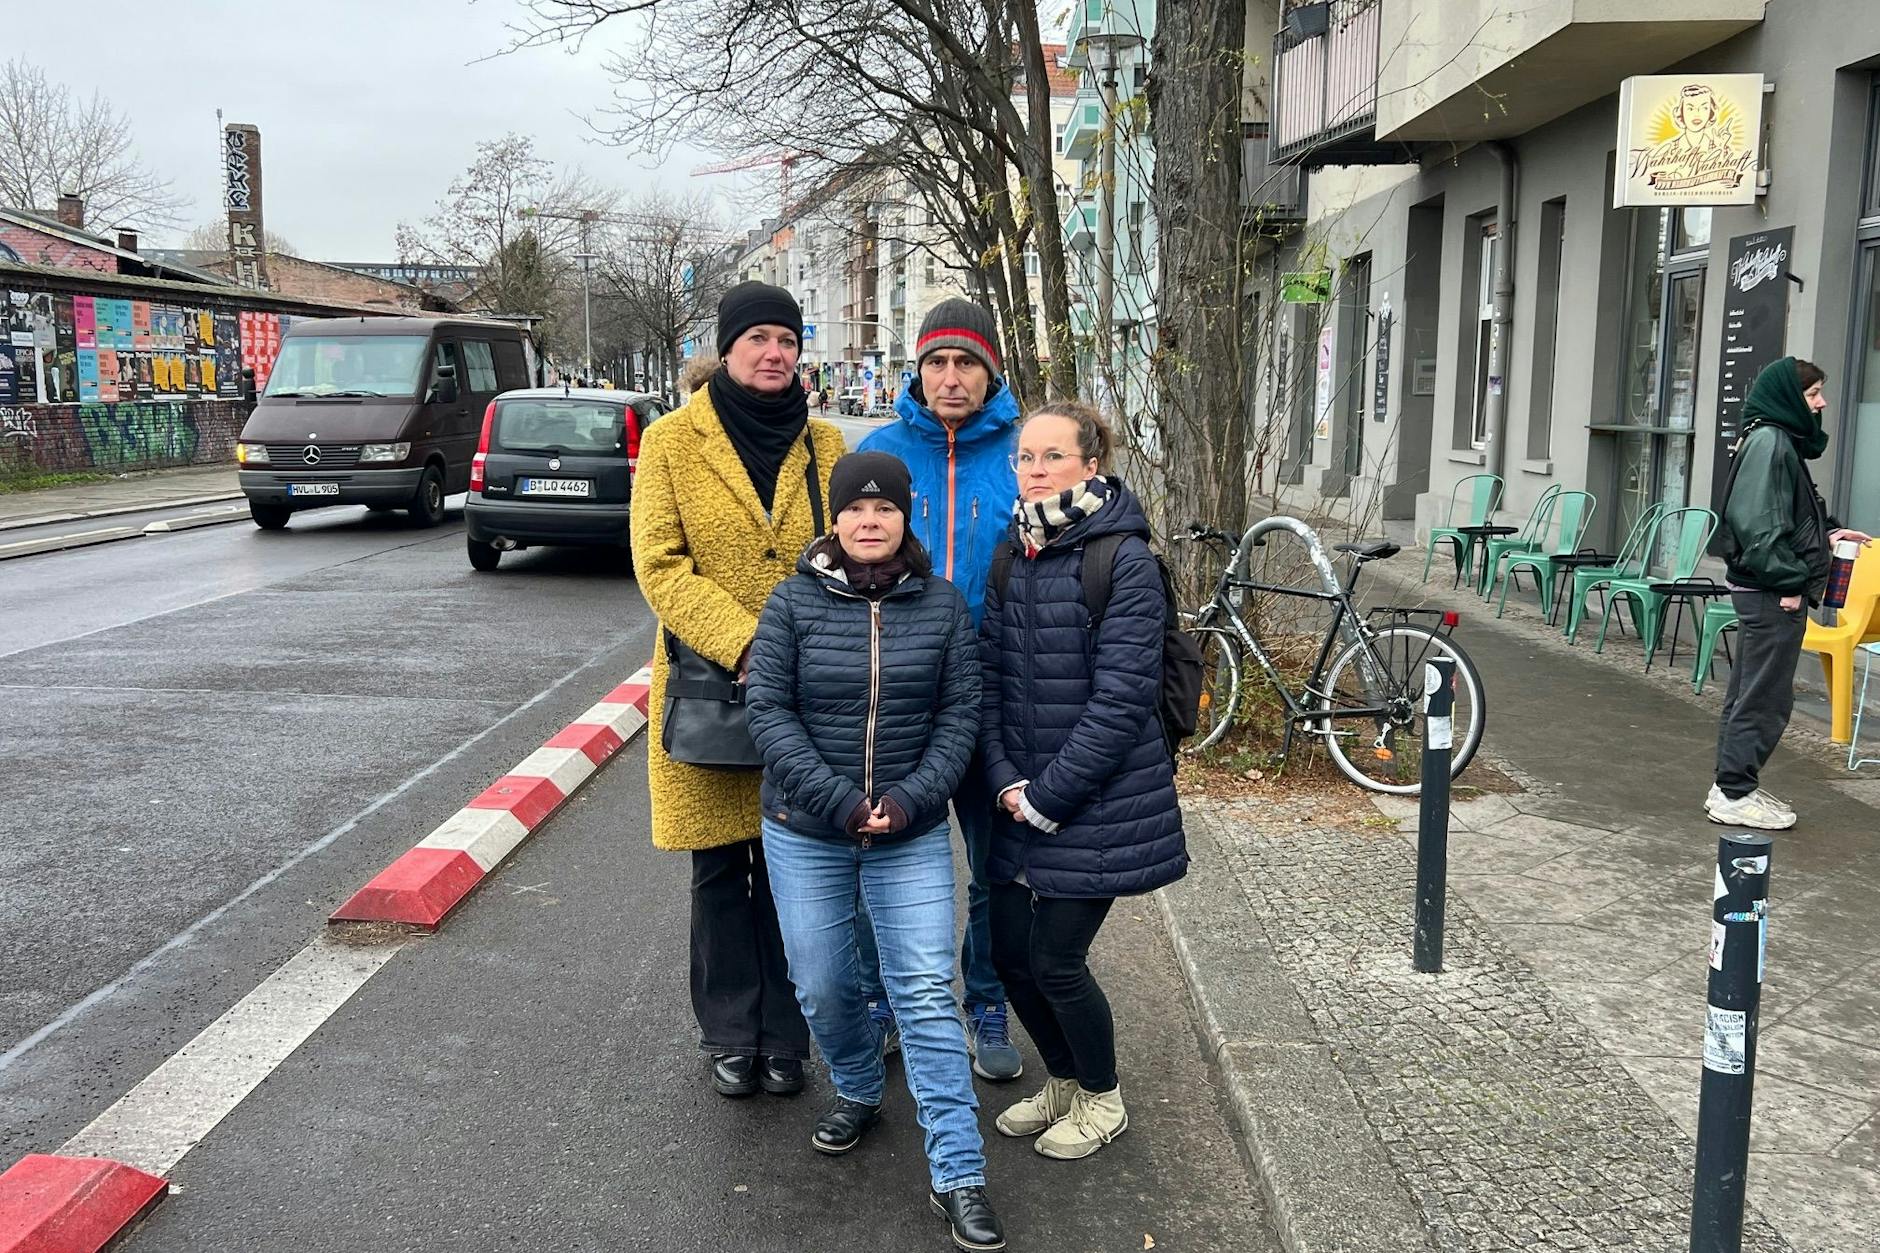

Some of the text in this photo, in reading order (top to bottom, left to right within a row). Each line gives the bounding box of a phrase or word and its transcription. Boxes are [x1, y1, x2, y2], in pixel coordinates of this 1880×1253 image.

[1629, 143, 1701, 178] Wahrhaft
[292, 484, 338, 494] HVL L 905
[530, 481, 587, 493] B LQ 4462
